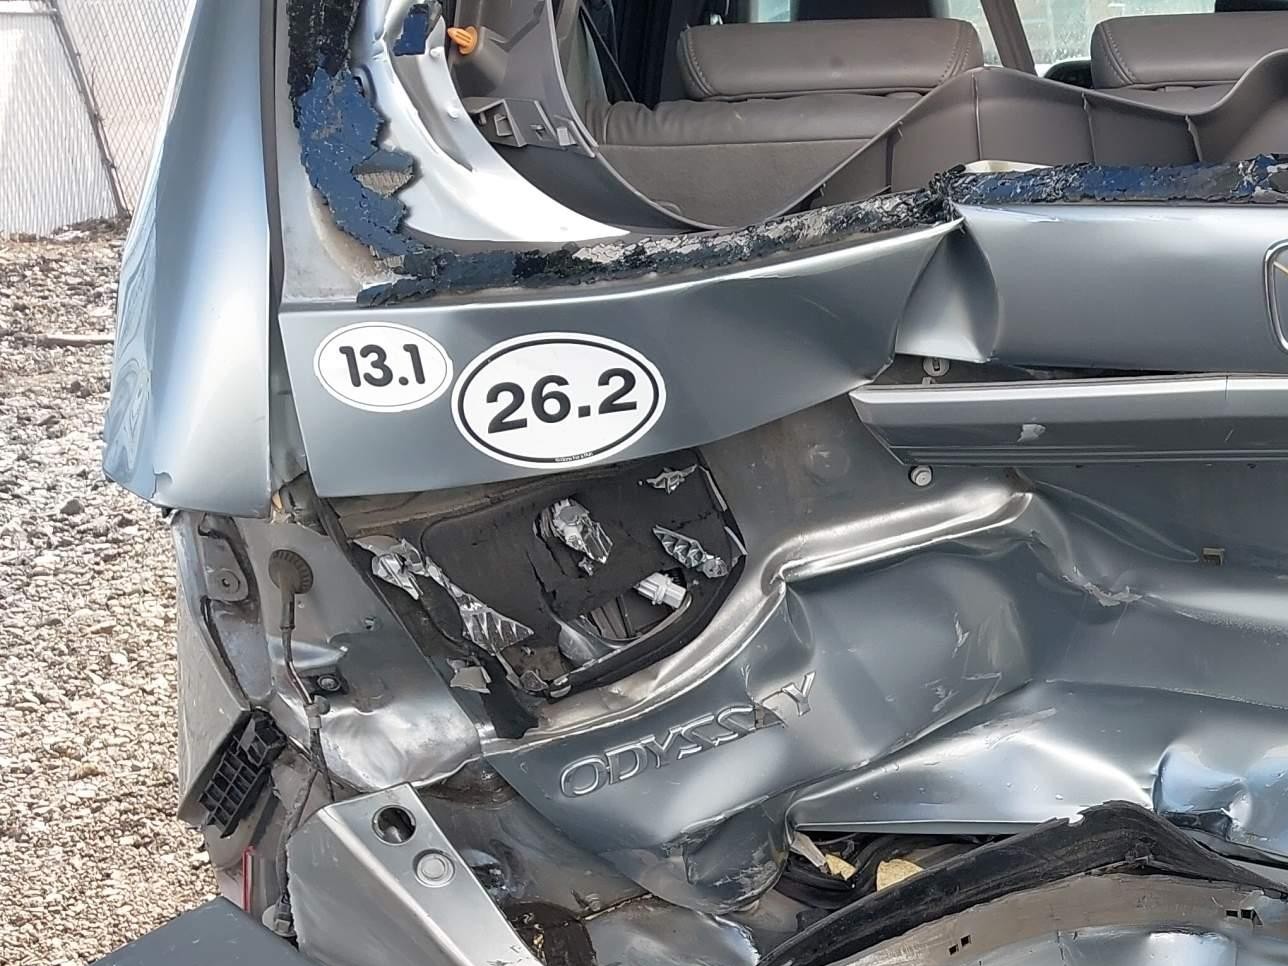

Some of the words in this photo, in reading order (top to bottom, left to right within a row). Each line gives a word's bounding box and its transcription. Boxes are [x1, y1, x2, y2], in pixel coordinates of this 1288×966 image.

[339, 343, 426, 388] 13.1
[485, 367, 638, 434] 26.2
[560, 671, 817, 797] ODYSSY
